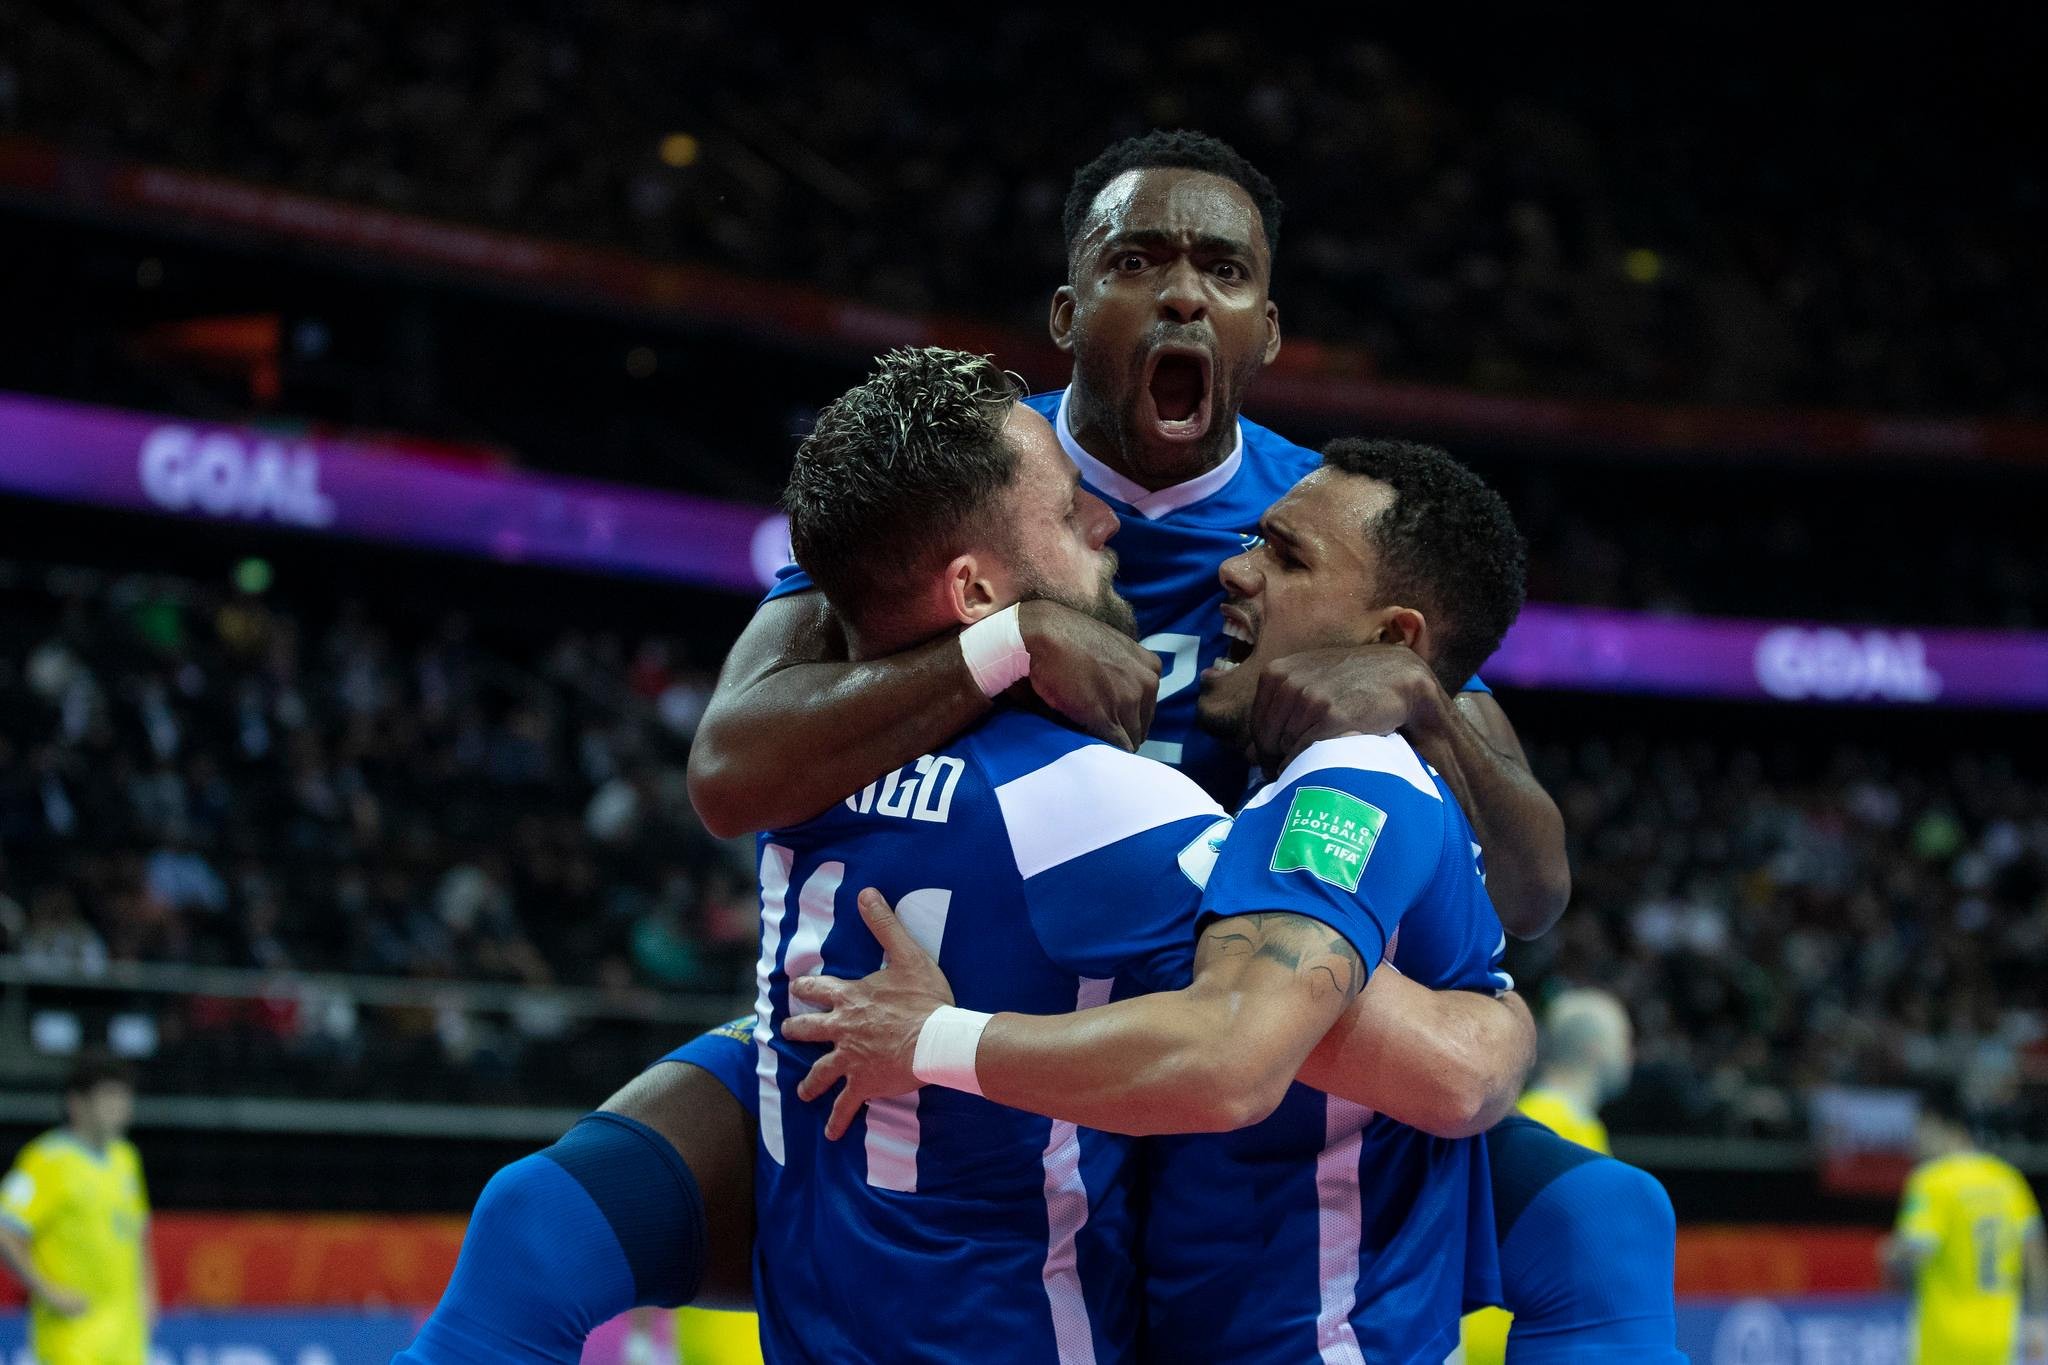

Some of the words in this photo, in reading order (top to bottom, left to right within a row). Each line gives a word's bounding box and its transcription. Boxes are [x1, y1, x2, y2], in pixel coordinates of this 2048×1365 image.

[139, 424, 336, 528] GOAL
[1755, 624, 1943, 703] GOAL
[1292, 818, 1366, 846] FOOTBALL
[1295, 809, 1370, 837] LIVING
[1324, 843, 1358, 865] FIFA
